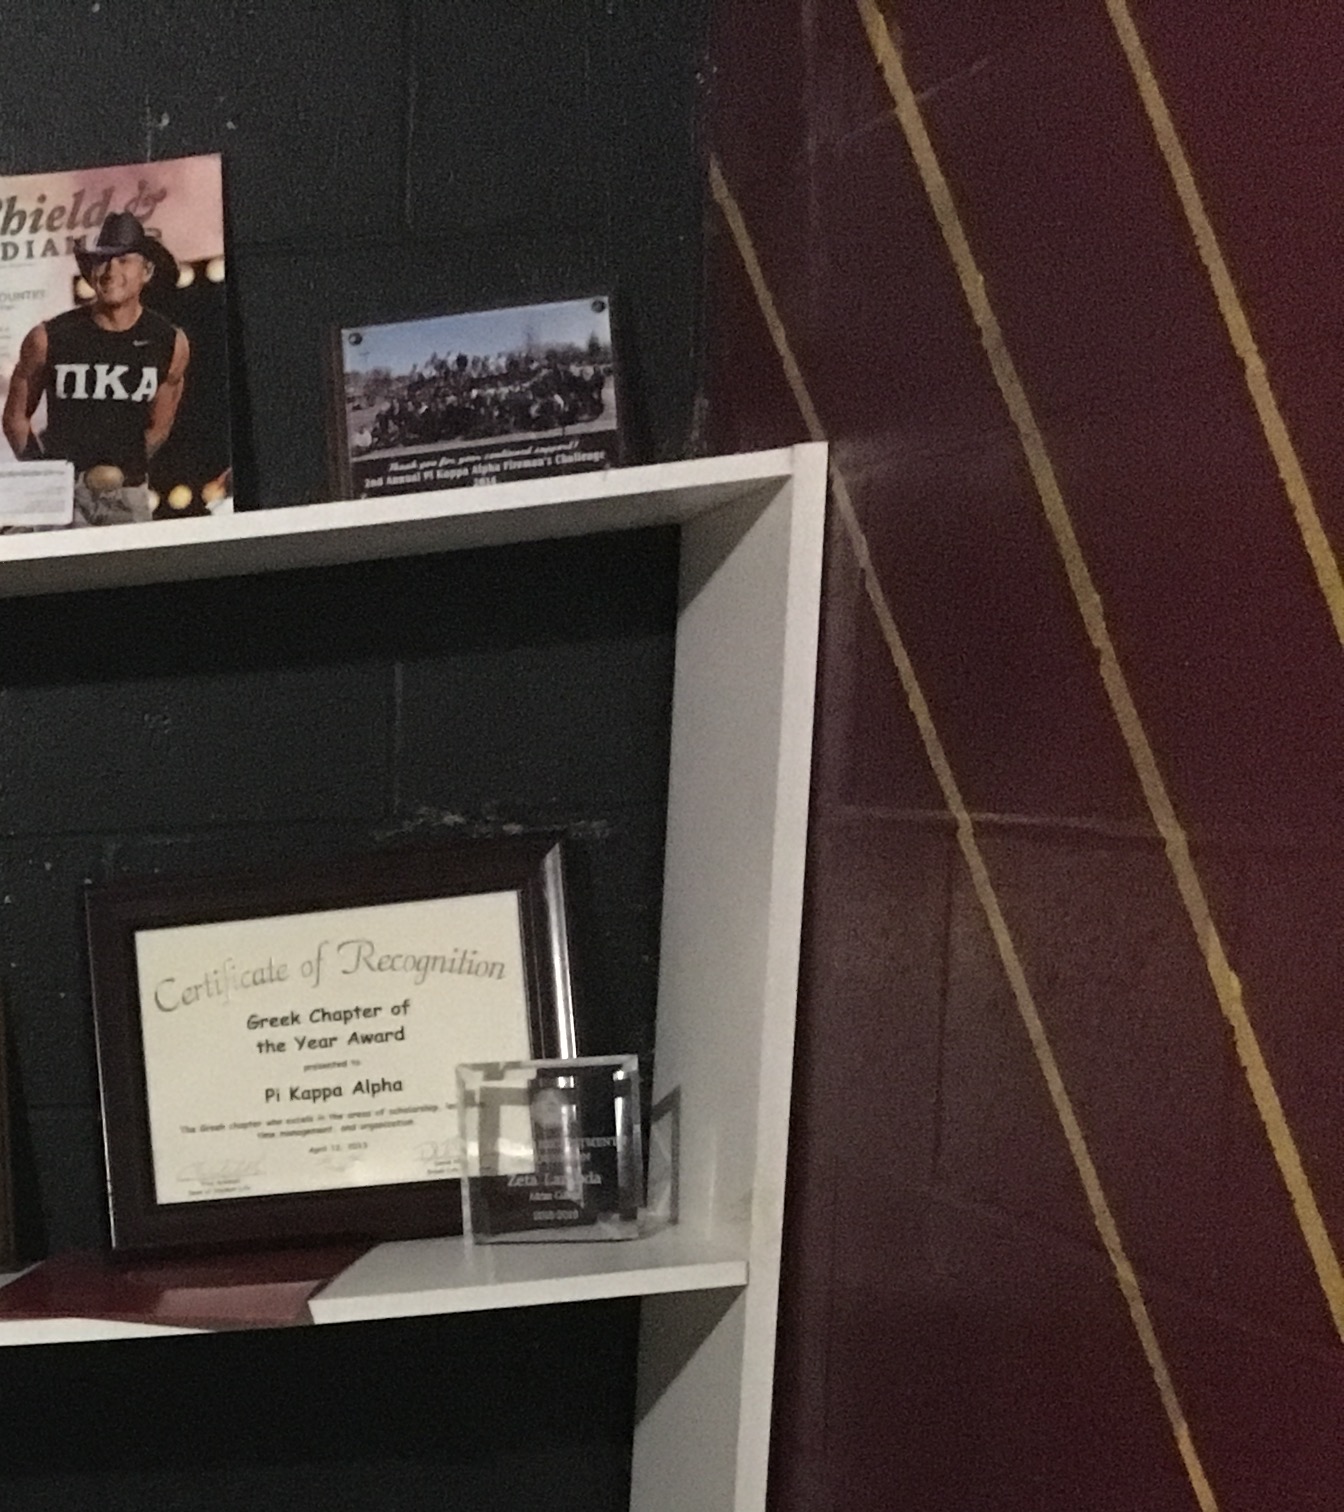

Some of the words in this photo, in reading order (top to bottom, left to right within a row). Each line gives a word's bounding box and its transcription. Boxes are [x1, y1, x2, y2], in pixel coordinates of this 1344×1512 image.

[153, 956, 290, 1013] Certificate
[300, 940, 330, 988] of
[337, 939, 507, 986] Recognition
[246, 1012, 302, 1030] Greek
[308, 1003, 383, 1029] Chapter
[390, 998, 411, 1018] of
[256, 1037, 287, 1055] the
[294, 1033, 339, 1052] Year
[347, 1026, 406, 1047] Award
[264, 1088, 281, 1104] Pi
[289, 1081, 343, 1104] Kappa
[352, 1076, 404, 1098] Alpha
